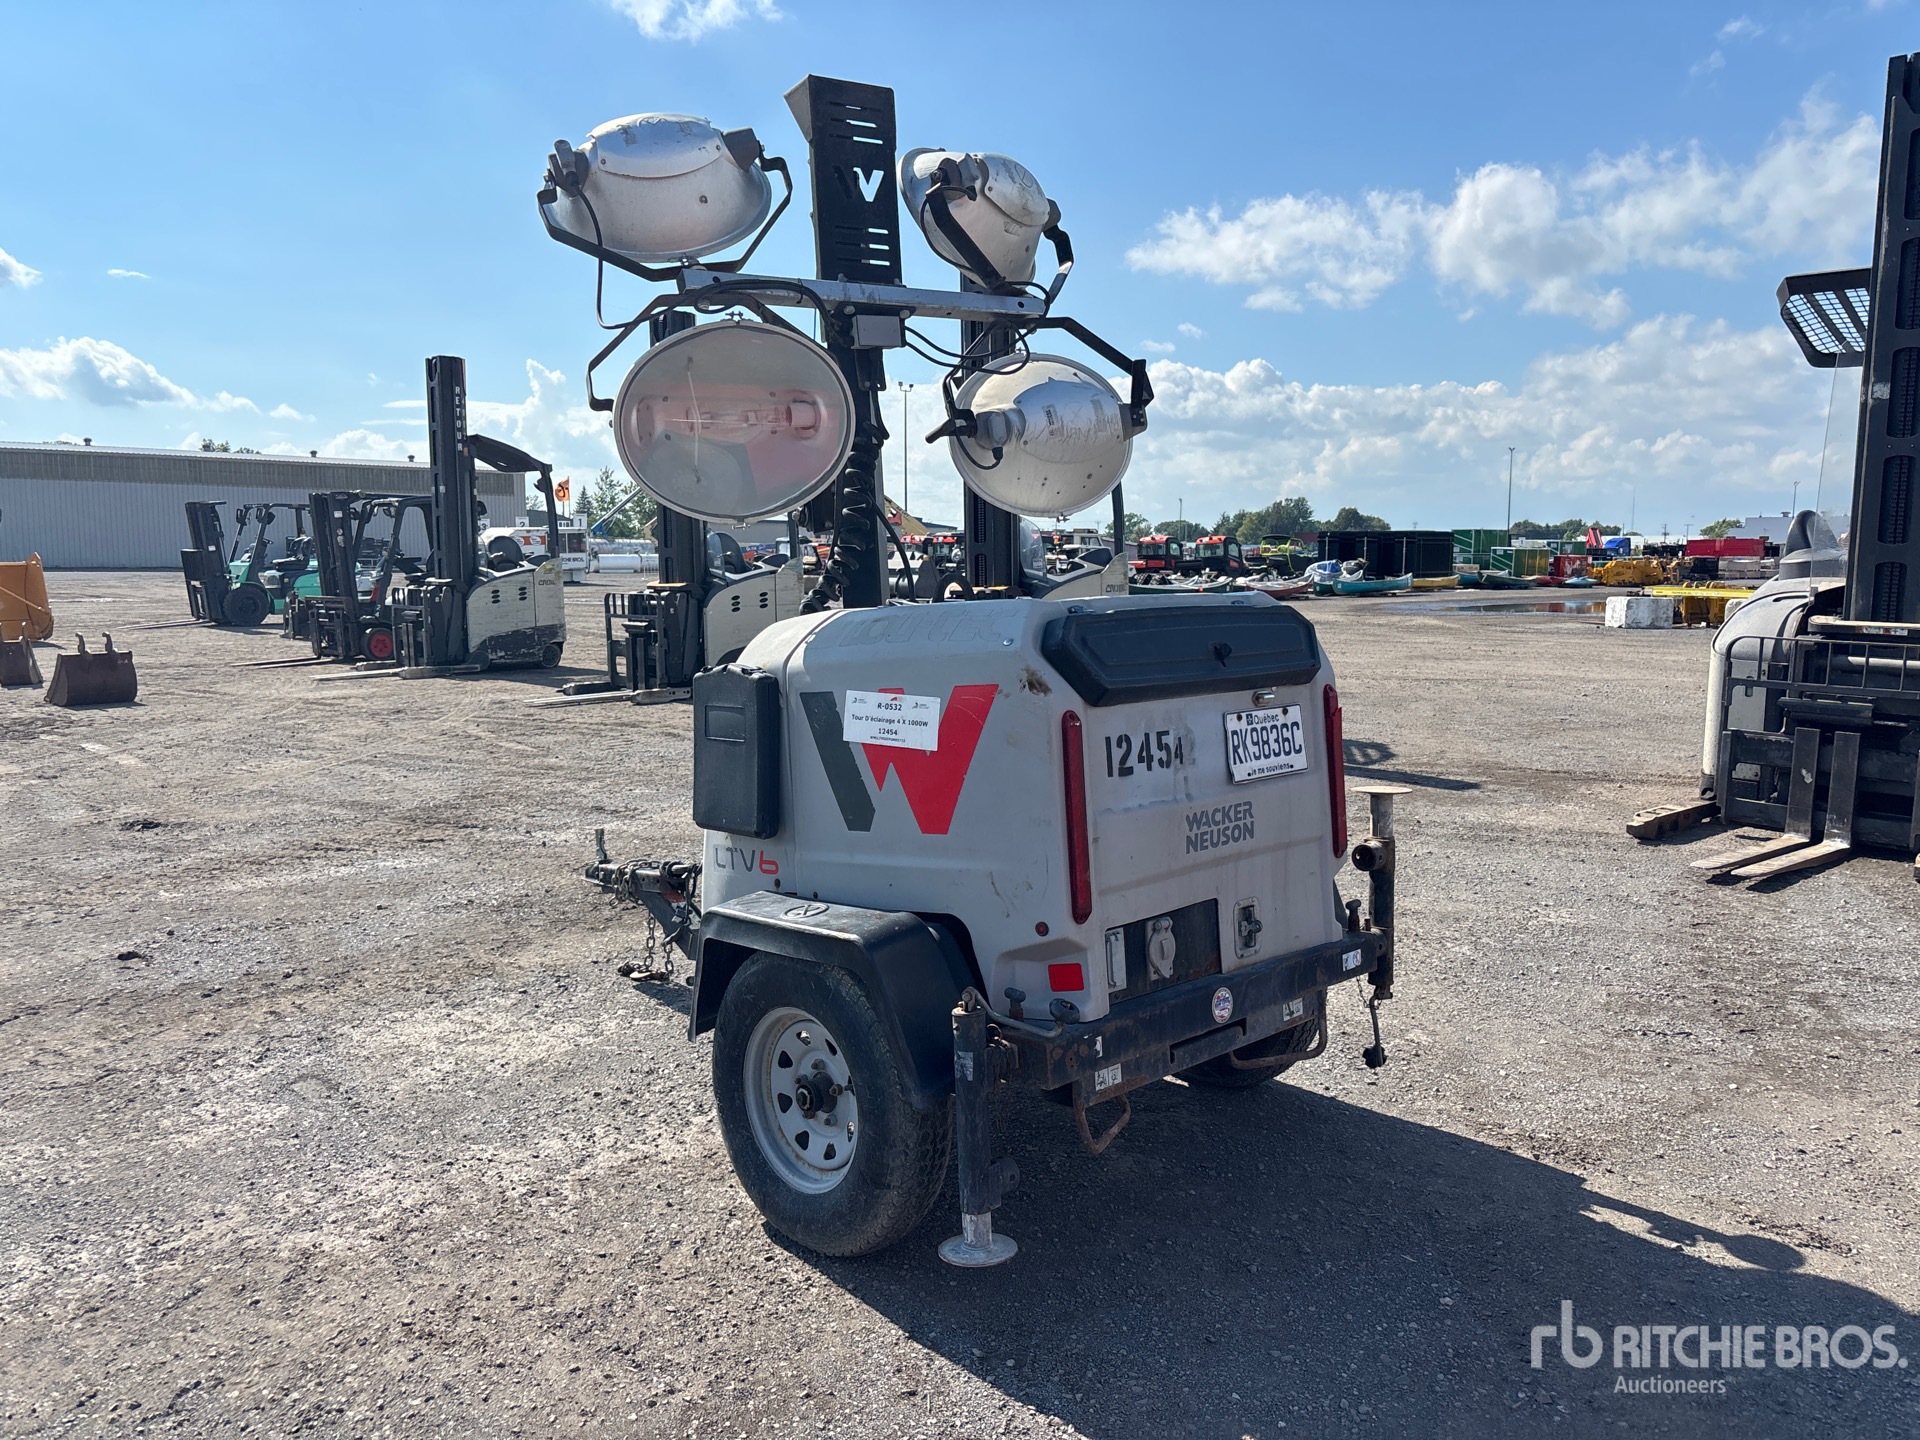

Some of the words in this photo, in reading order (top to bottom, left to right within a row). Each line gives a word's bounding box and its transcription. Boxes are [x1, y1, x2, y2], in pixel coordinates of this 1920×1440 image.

[455, 386, 463, 452] RETOUR
[877, 702, 902, 712] R-0532
[851, 713, 864, 721] Tour
[907, 719, 929, 728] 1000W
[1253, 713, 1280, 725] Québec
[878, 727, 898, 736] 12454
[1231, 721, 1303, 766] RK9836C
[1265, 762, 1290, 773] souviens
[1185, 800, 1254, 832] WACKER
[1185, 820, 1255, 855] NEUSON
[715, 846, 779, 875] LTV6
